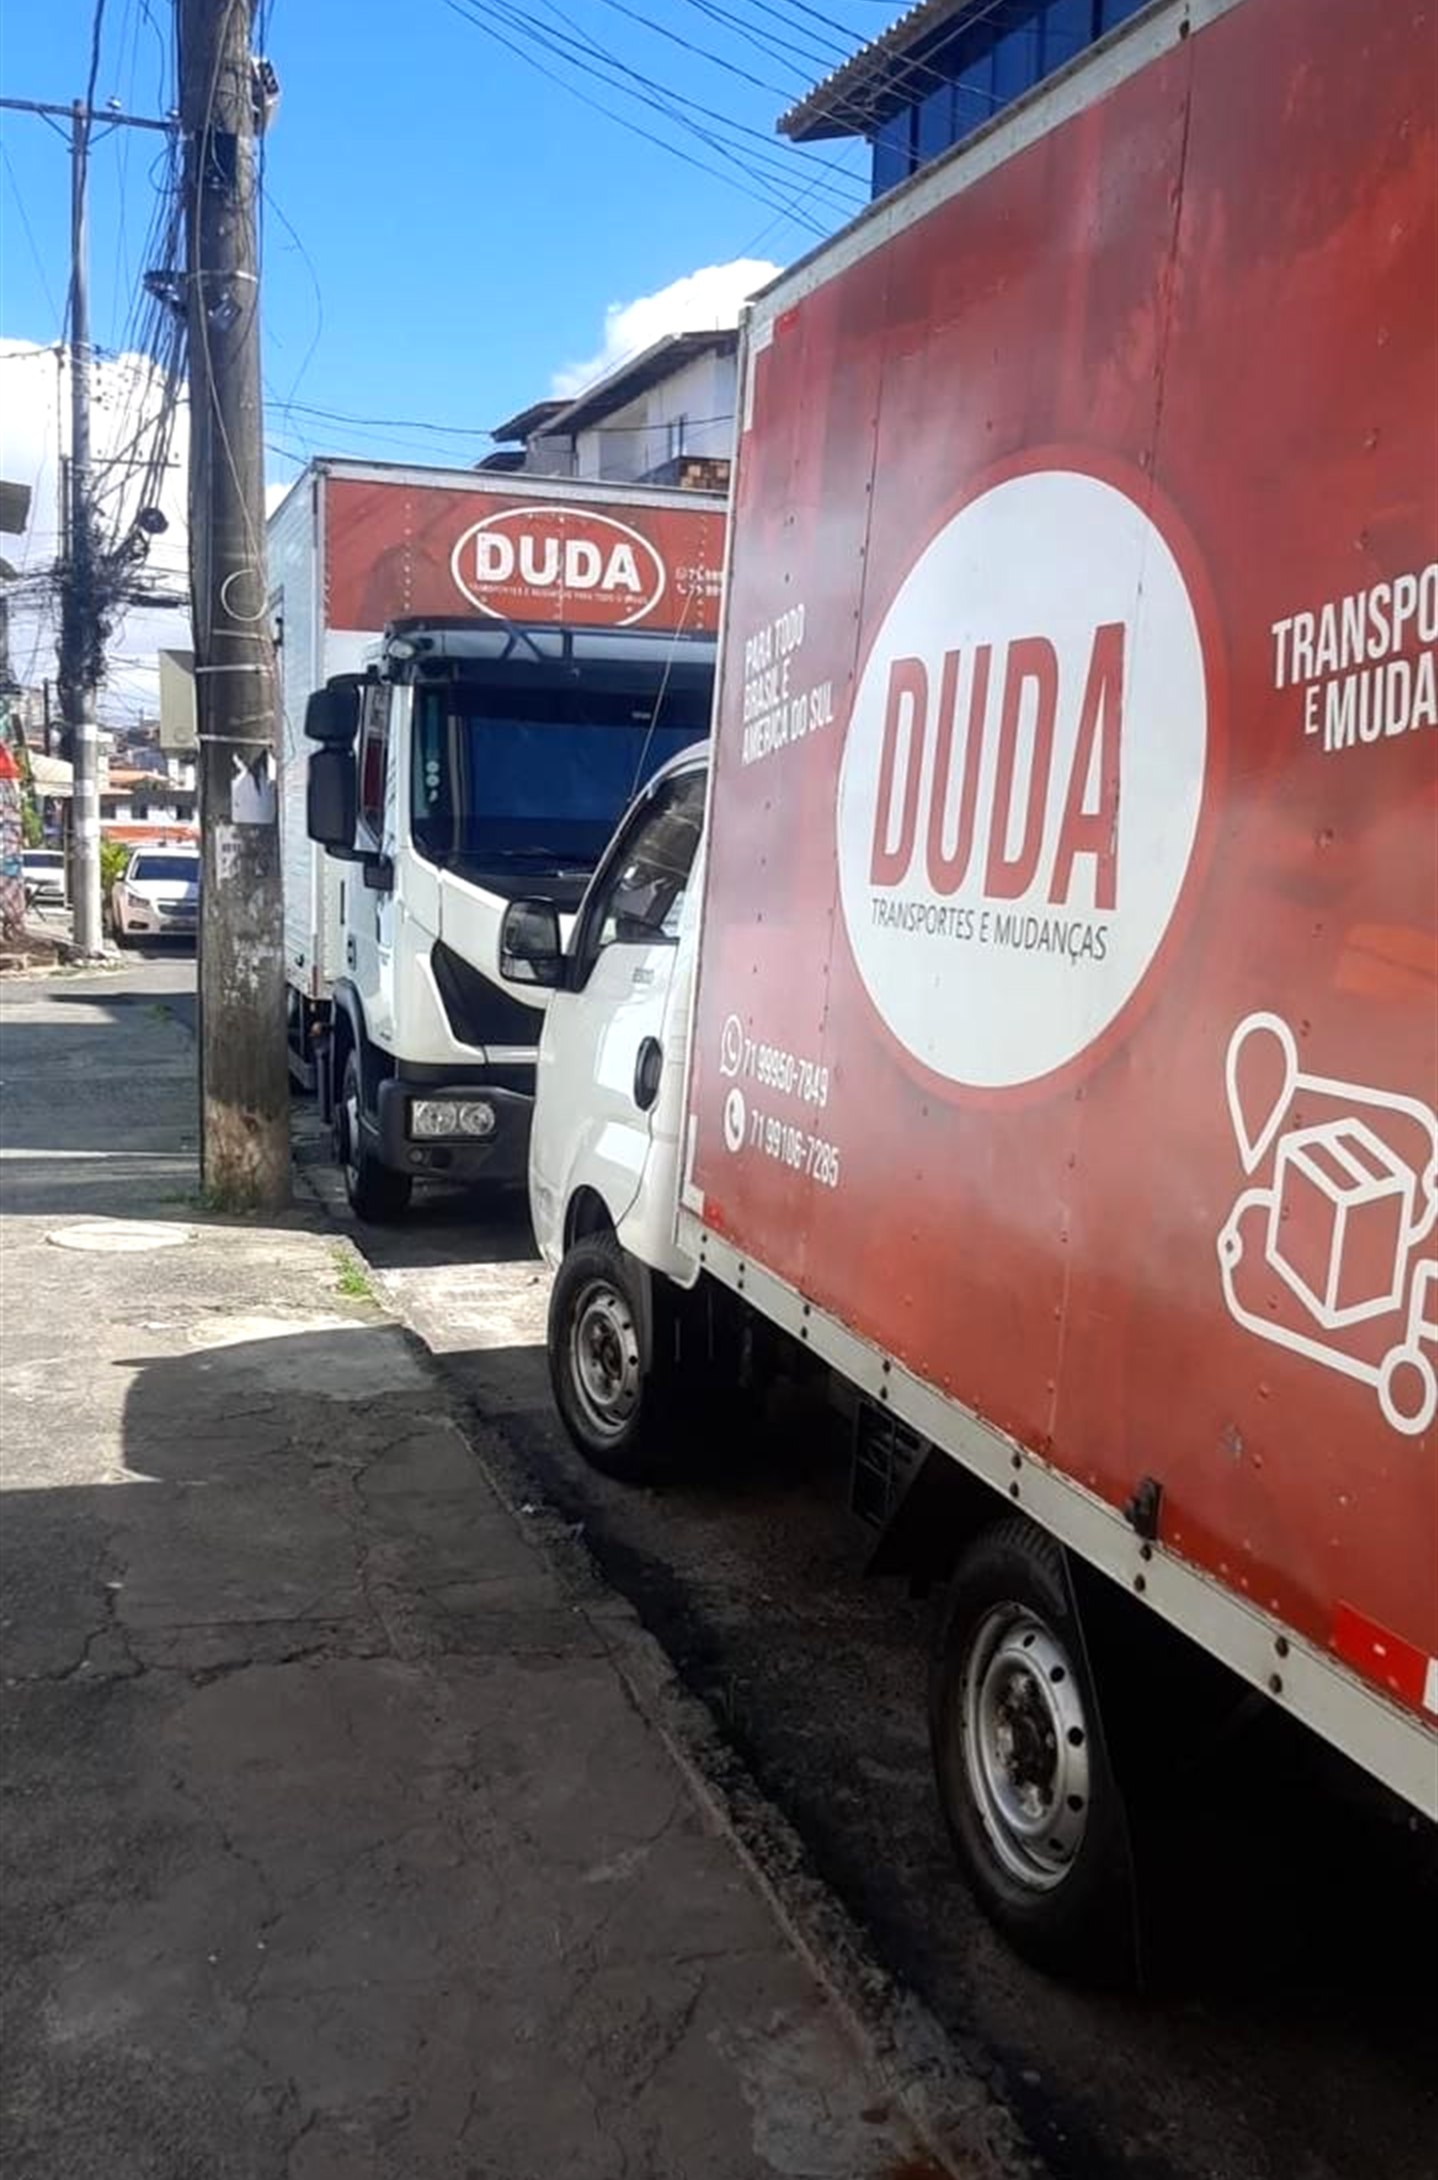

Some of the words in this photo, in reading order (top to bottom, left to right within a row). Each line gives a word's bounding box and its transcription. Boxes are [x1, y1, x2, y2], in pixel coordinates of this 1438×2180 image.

[476, 531, 642, 592] DUDA
[1271, 564, 1438, 688] TRANSPO
[782, 657, 791, 699] E
[1304, 685, 1320, 734] E
[1324, 651, 1438, 752] MUDA
[870, 621, 1126, 910] DUDA
[872, 899, 974, 940] TRANSPORTES
[979, 912, 990, 942] E
[994, 914, 1108, 965] MUDANÇAS
[743, 1038, 757, 1077] 71
[751, 1109, 765, 1149] 71
